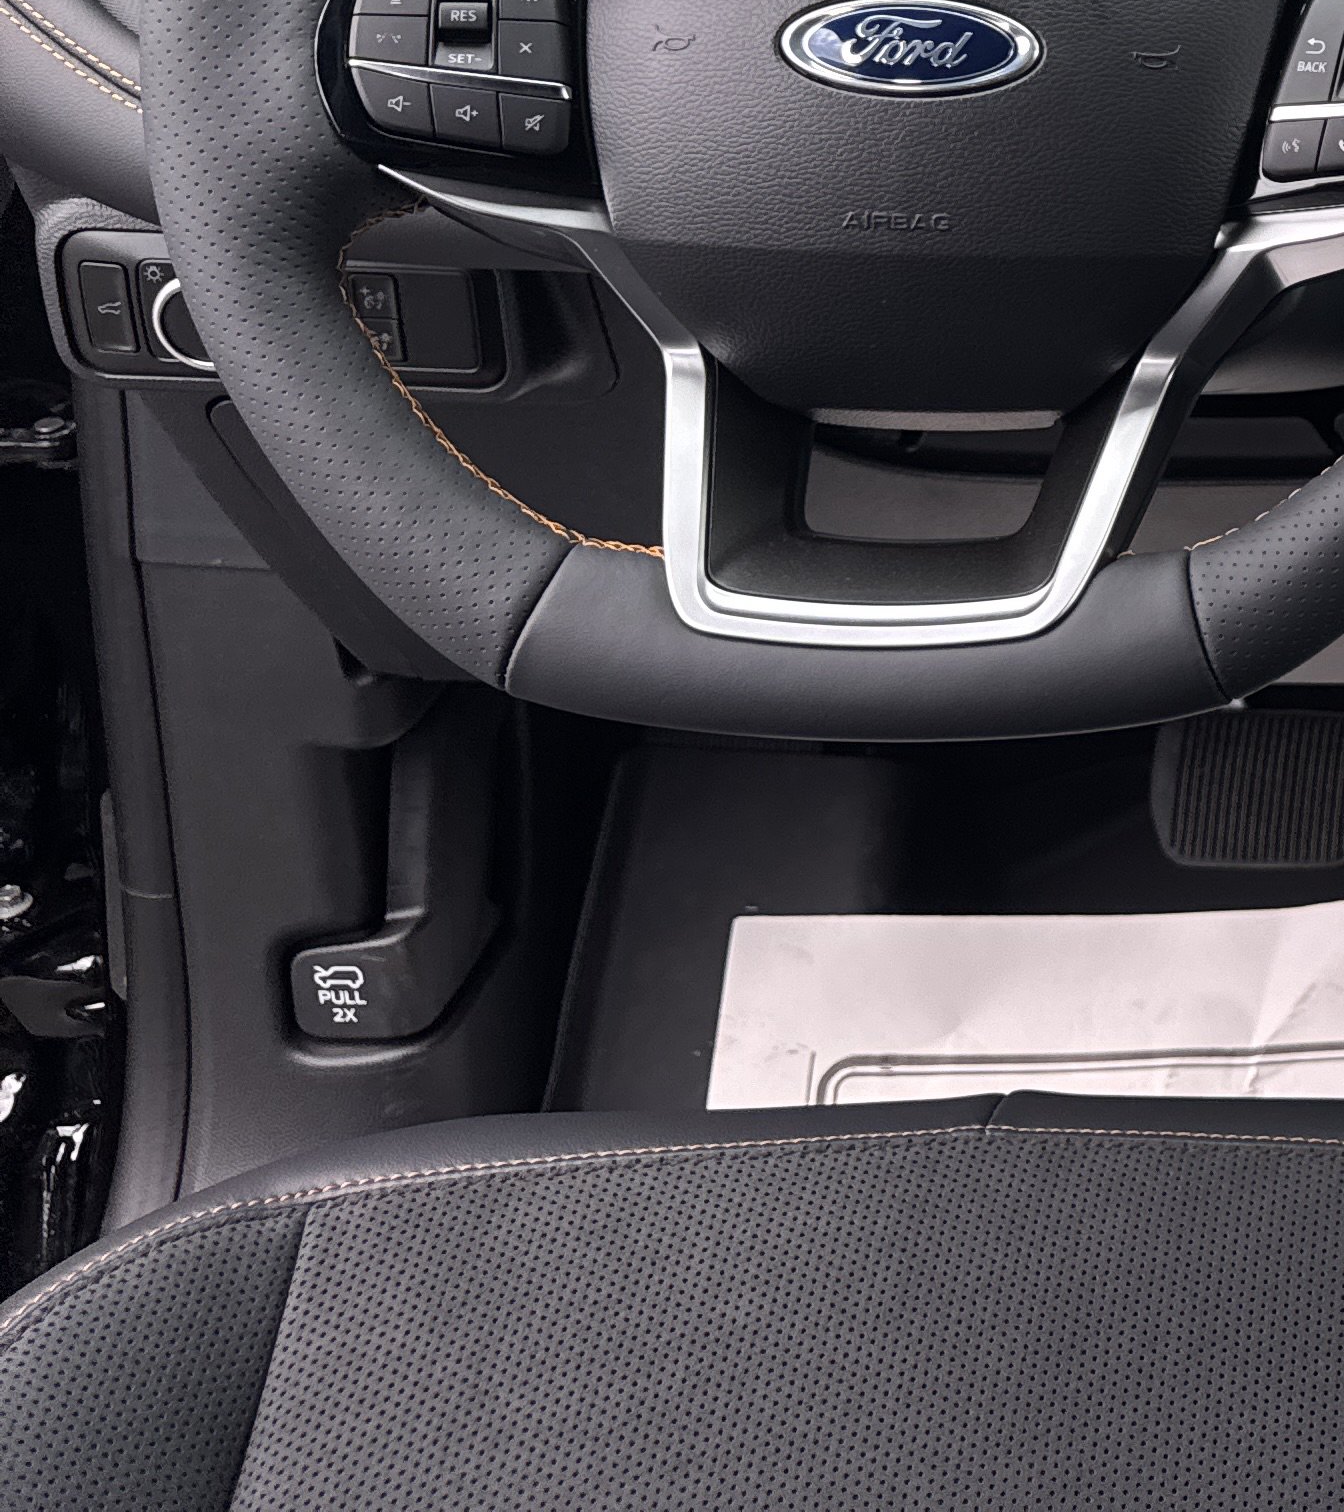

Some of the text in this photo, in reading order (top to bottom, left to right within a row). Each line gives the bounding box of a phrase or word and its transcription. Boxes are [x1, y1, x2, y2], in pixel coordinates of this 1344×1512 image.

[450, 8, 478, 23] RES
[841, 14, 974, 69] Ford
[1296, 60, 1328, 74] BACK
[842, 211, 952, 232] AIRBAG
[318, 990, 368, 1006] PULL
[332, 1007, 359, 1023] 2X
